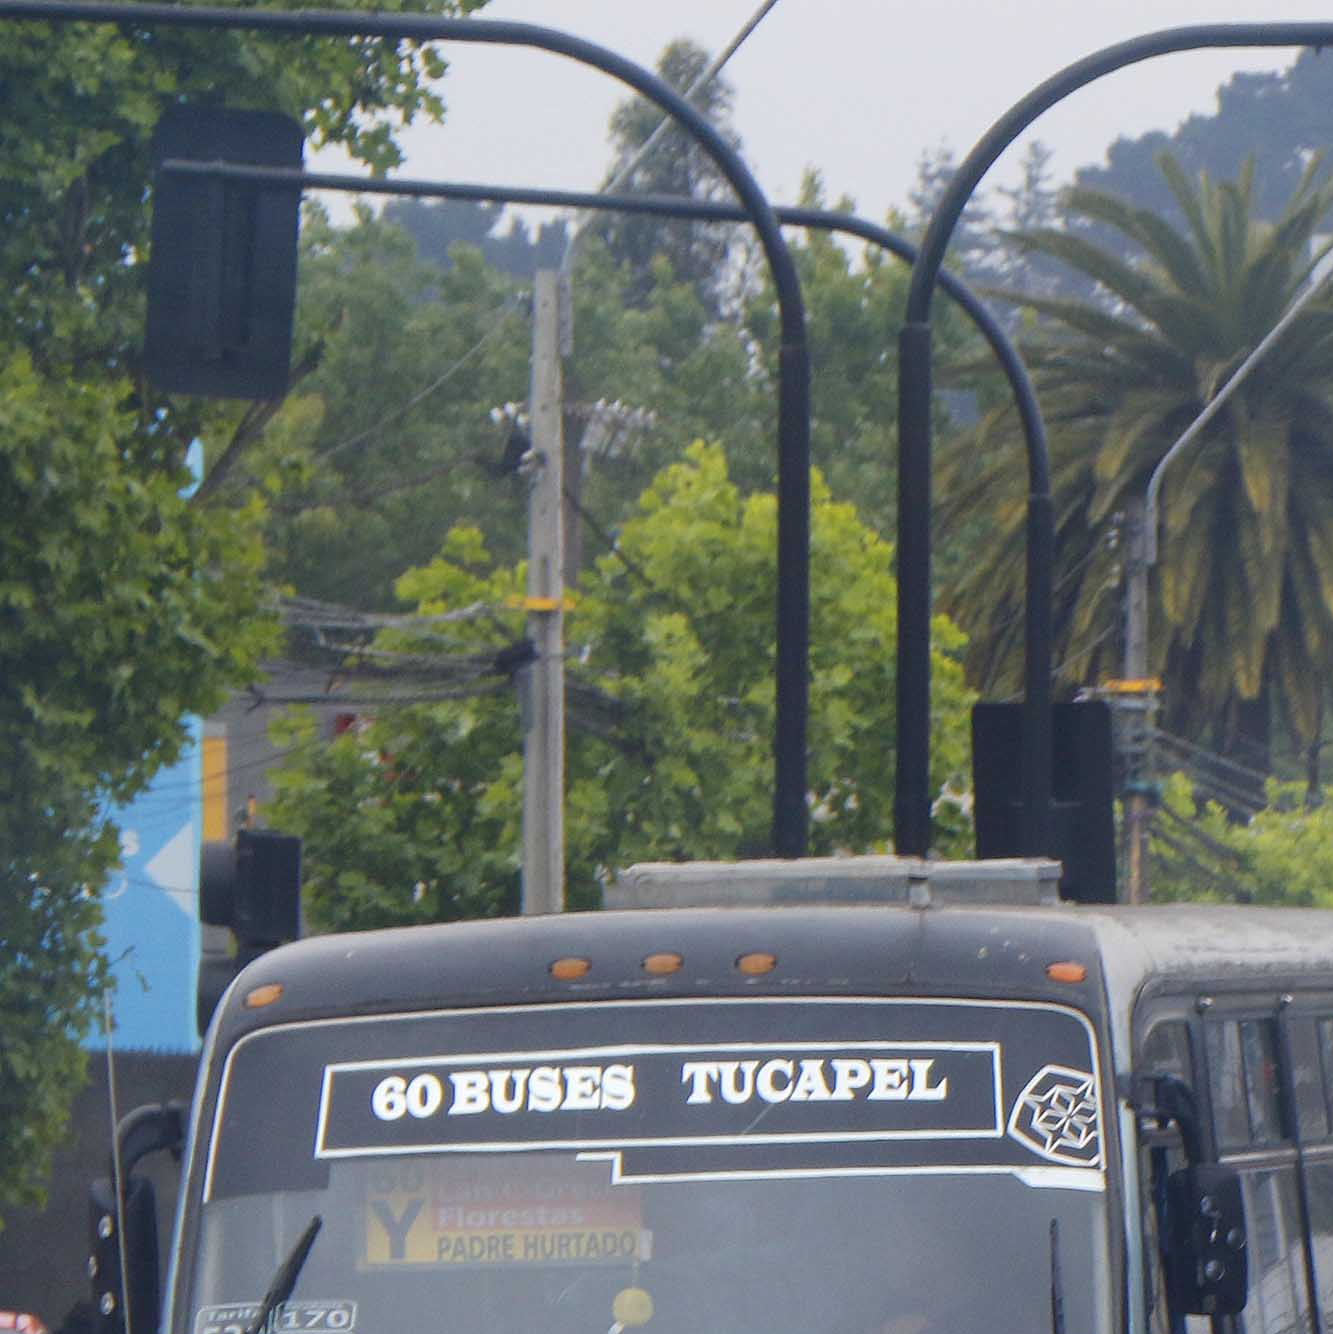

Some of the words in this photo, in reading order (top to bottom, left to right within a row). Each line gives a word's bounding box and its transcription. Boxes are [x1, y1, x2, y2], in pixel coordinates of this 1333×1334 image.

[372, 1070, 441, 1121] 60
[449, 1064, 635, 1115] BUSES
[682, 1057, 946, 1106] TUCAPEL
[371, 1200, 425, 1260] Y
[437, 1233, 514, 1261] PADRE
[524, 1231, 637, 1259] HURTADO
[282, 1309, 350, 1328] 170
